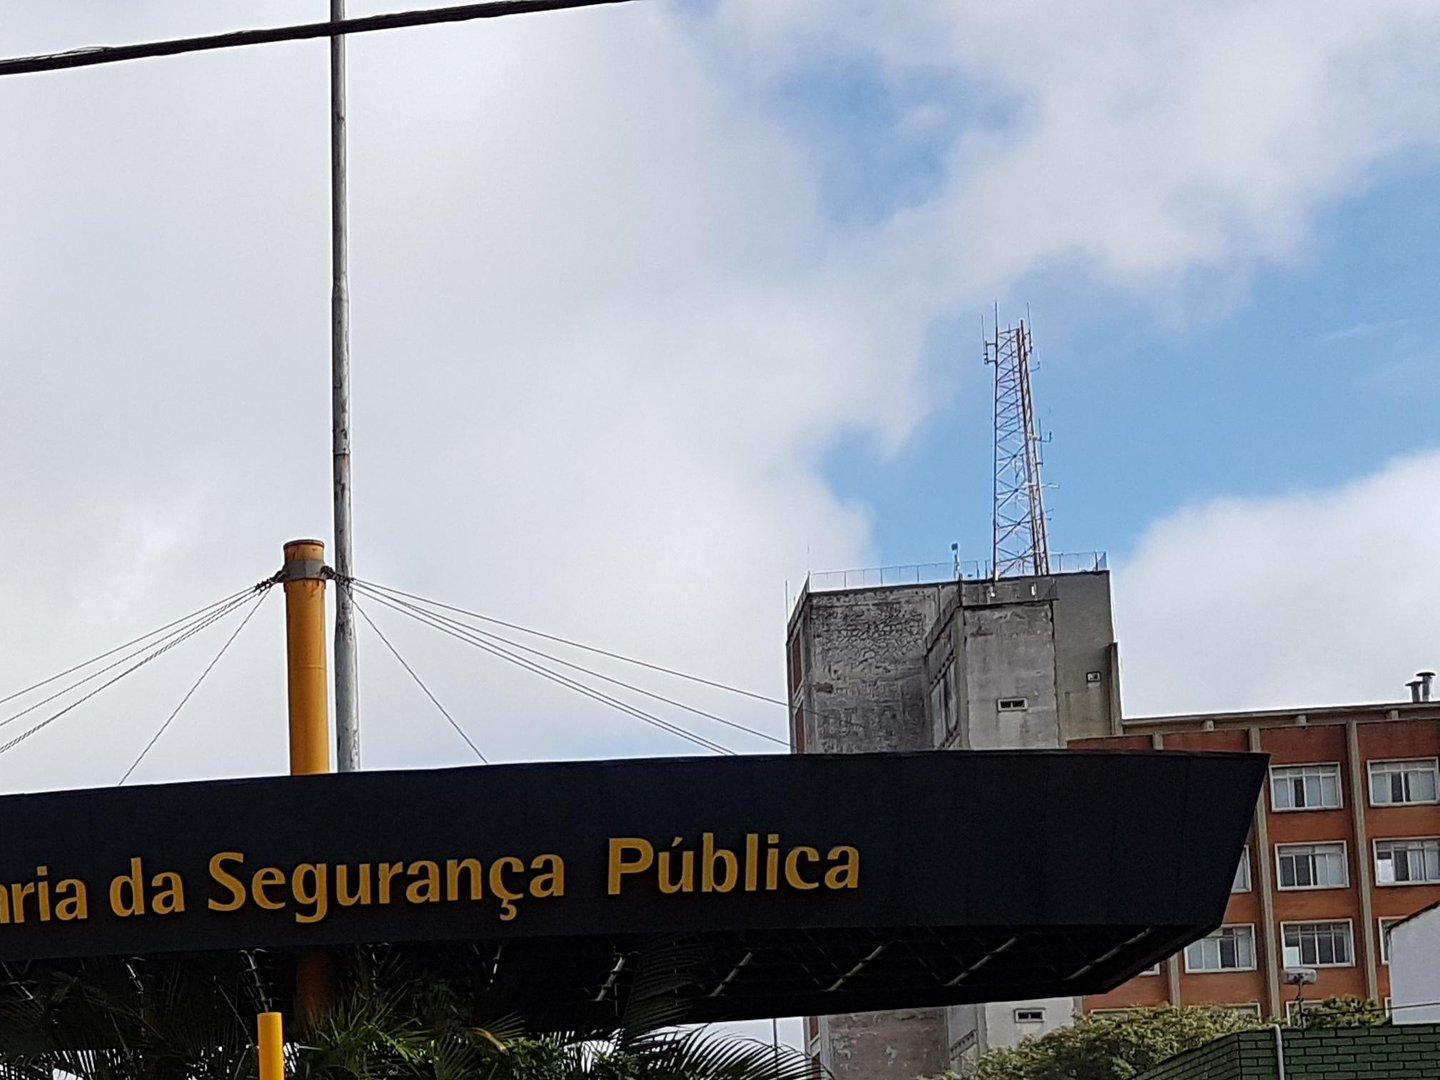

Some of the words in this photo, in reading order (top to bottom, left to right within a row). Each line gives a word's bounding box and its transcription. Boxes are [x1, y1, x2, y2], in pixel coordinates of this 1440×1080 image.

[109, 857, 186, 917] da
[208, 851, 565, 921] Segurança
[607, 832, 860, 896] Pública
